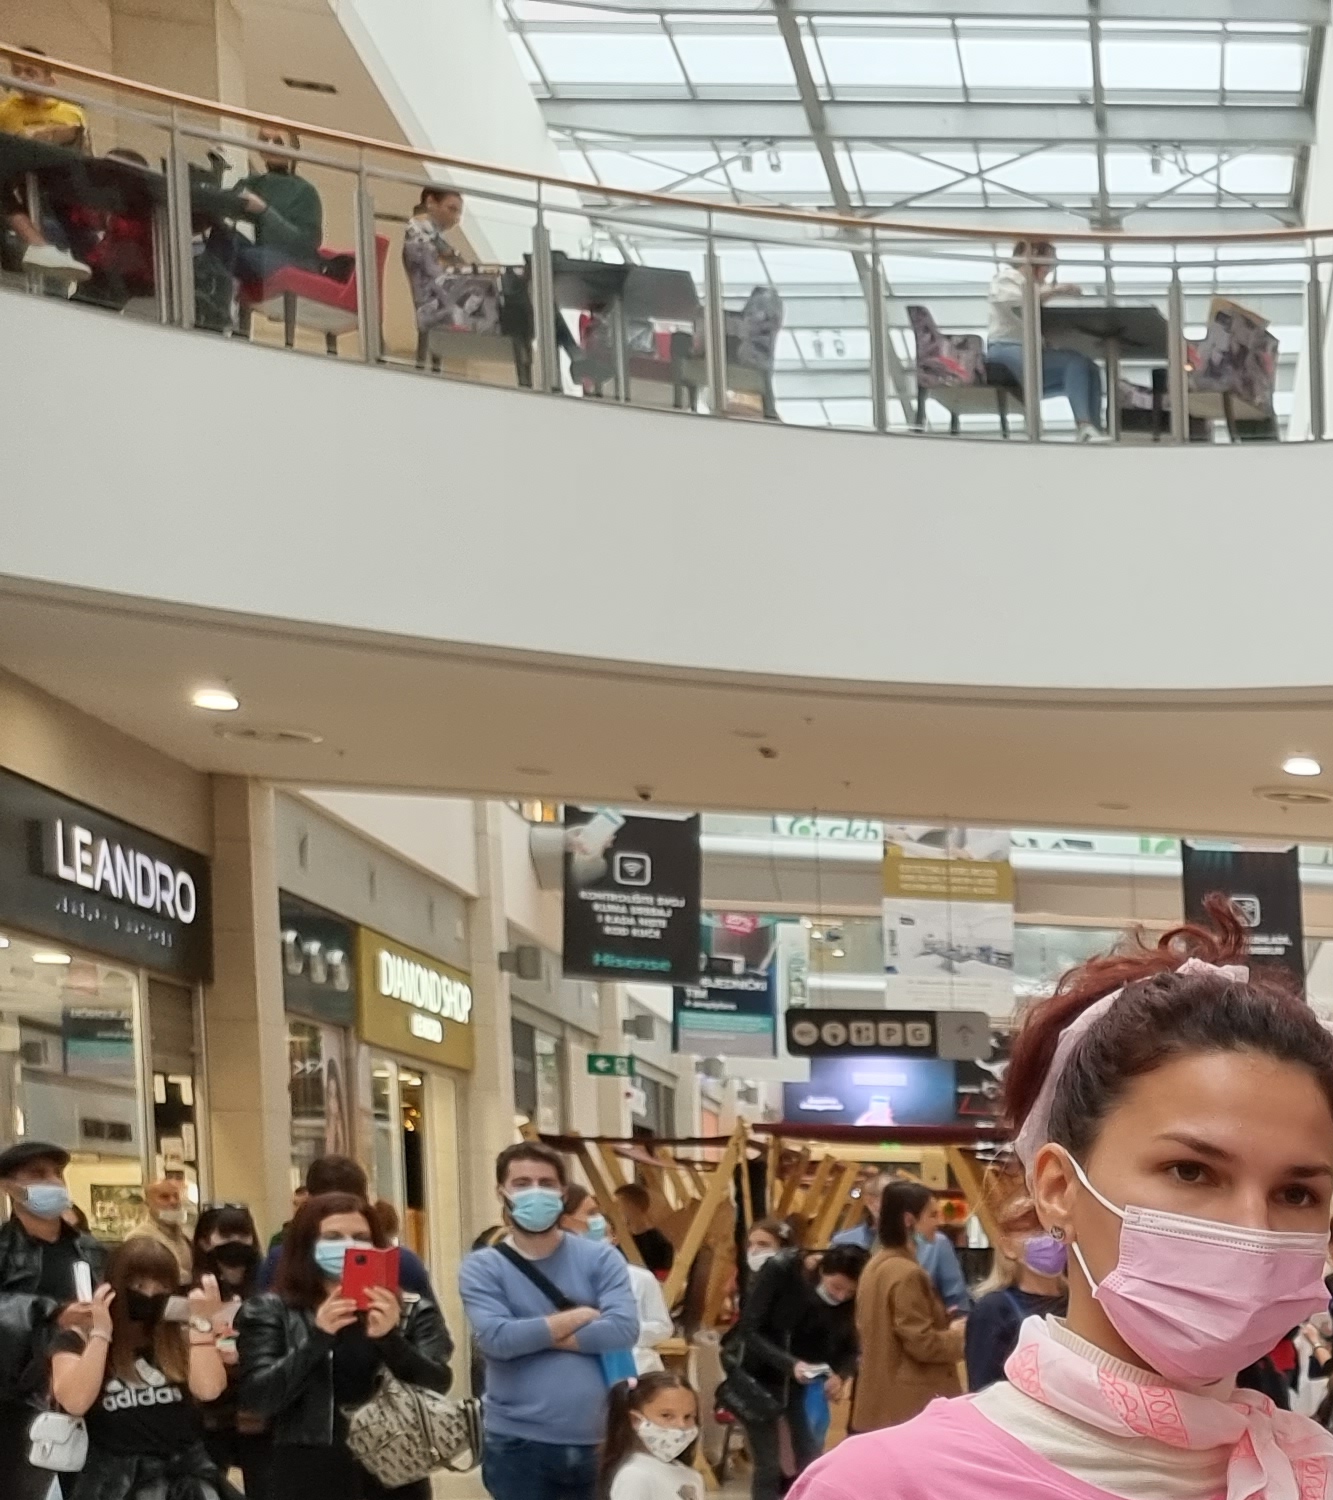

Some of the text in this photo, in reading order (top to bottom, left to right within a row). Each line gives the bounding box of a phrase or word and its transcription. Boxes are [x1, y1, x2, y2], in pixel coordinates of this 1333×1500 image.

[56, 818, 196, 923] LEANDRO
[379, 950, 472, 1025] DIAMOND SHOP
[103, 1387, 182, 1412] adidas
